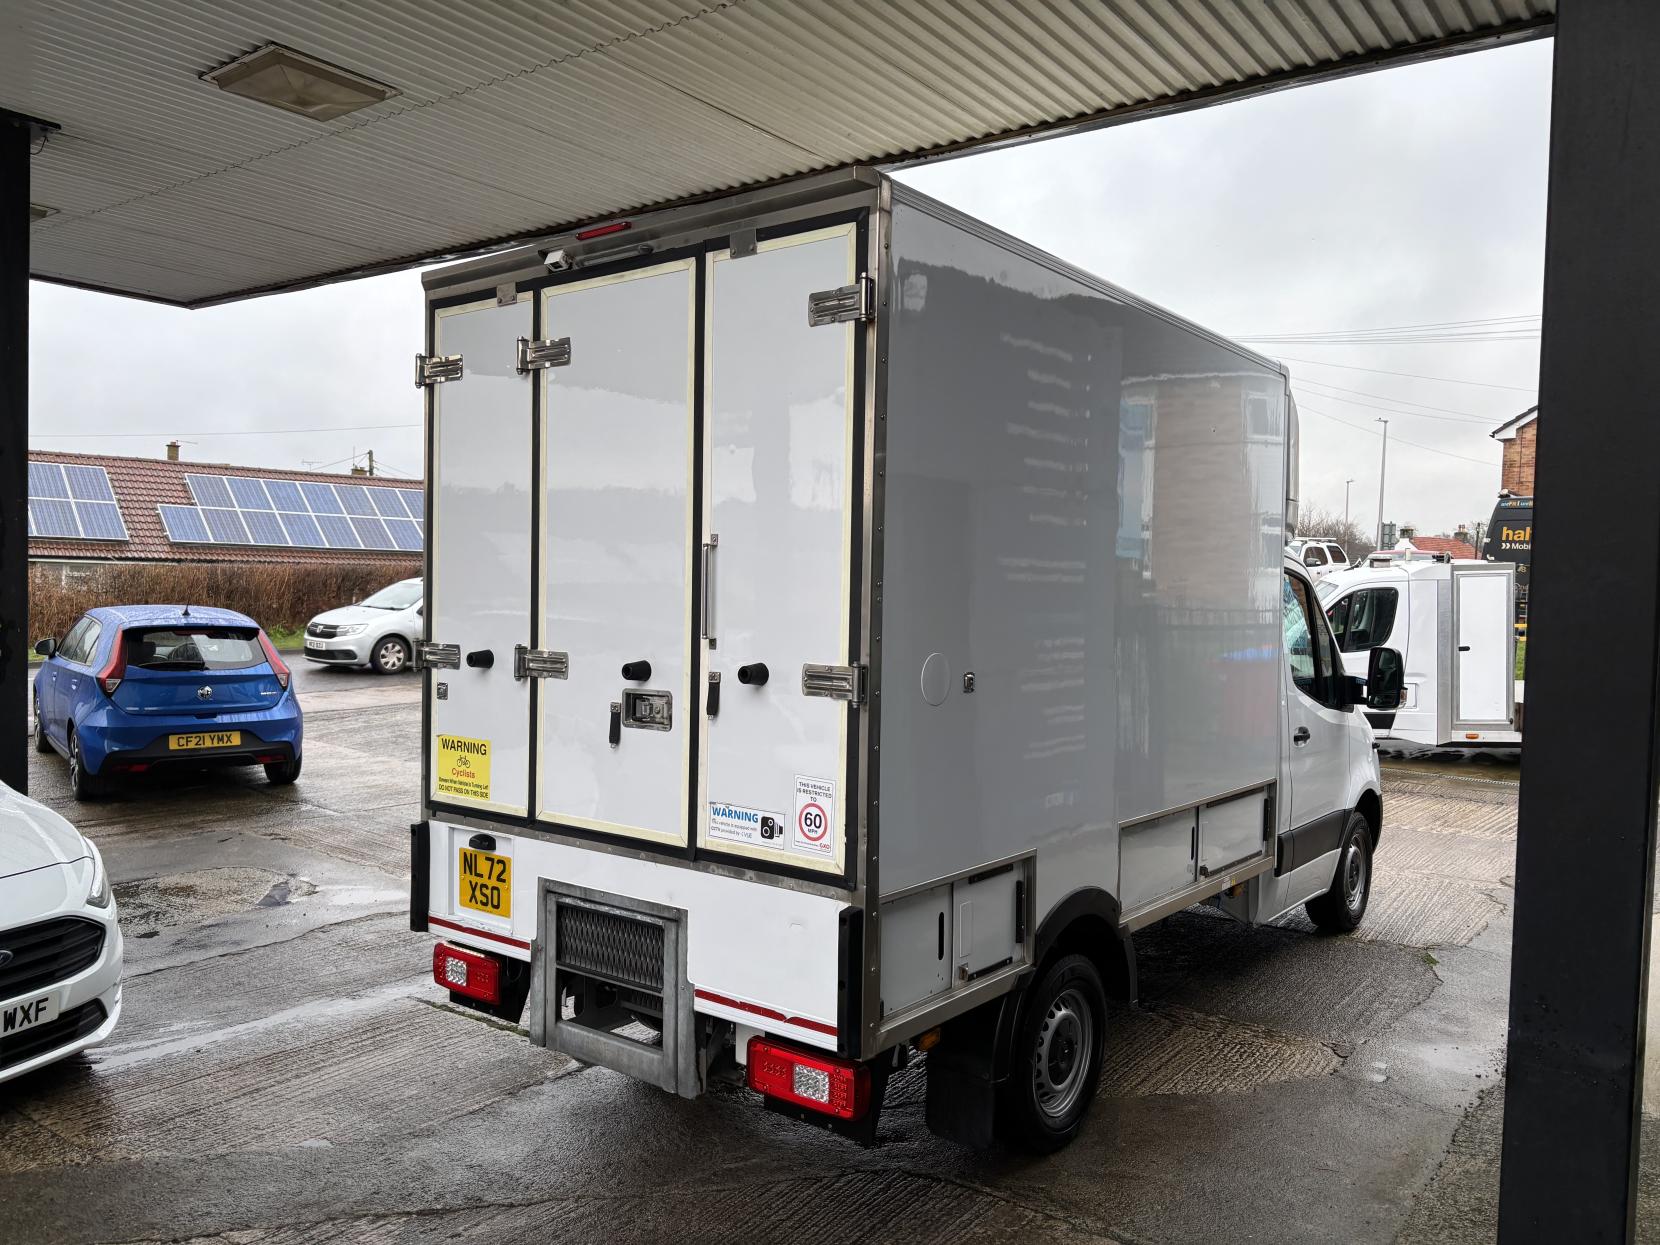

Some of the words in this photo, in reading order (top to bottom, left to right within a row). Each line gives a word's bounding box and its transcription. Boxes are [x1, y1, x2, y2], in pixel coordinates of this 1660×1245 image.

[177, 734, 206, 748] CF21
[209, 733, 233, 745] YMX
[441, 737, 487, 756] WARNING
[451, 767, 476, 779] Cyclists
[453, 786, 464, 794] PASS
[470, 789, 480, 798] THIS
[479, 791, 489, 799] SIDE
[798, 781, 810, 790] THIS
[810, 783, 831, 793] VEHICLE
[802, 788, 832, 799] RESTRICTED
[711, 806, 759, 824] WARNING
[804, 811, 823, 829] 60
[463, 851, 507, 884] NL72
[468, 879, 501, 910] XSO
[3, 997, 49, 1033] WXF
